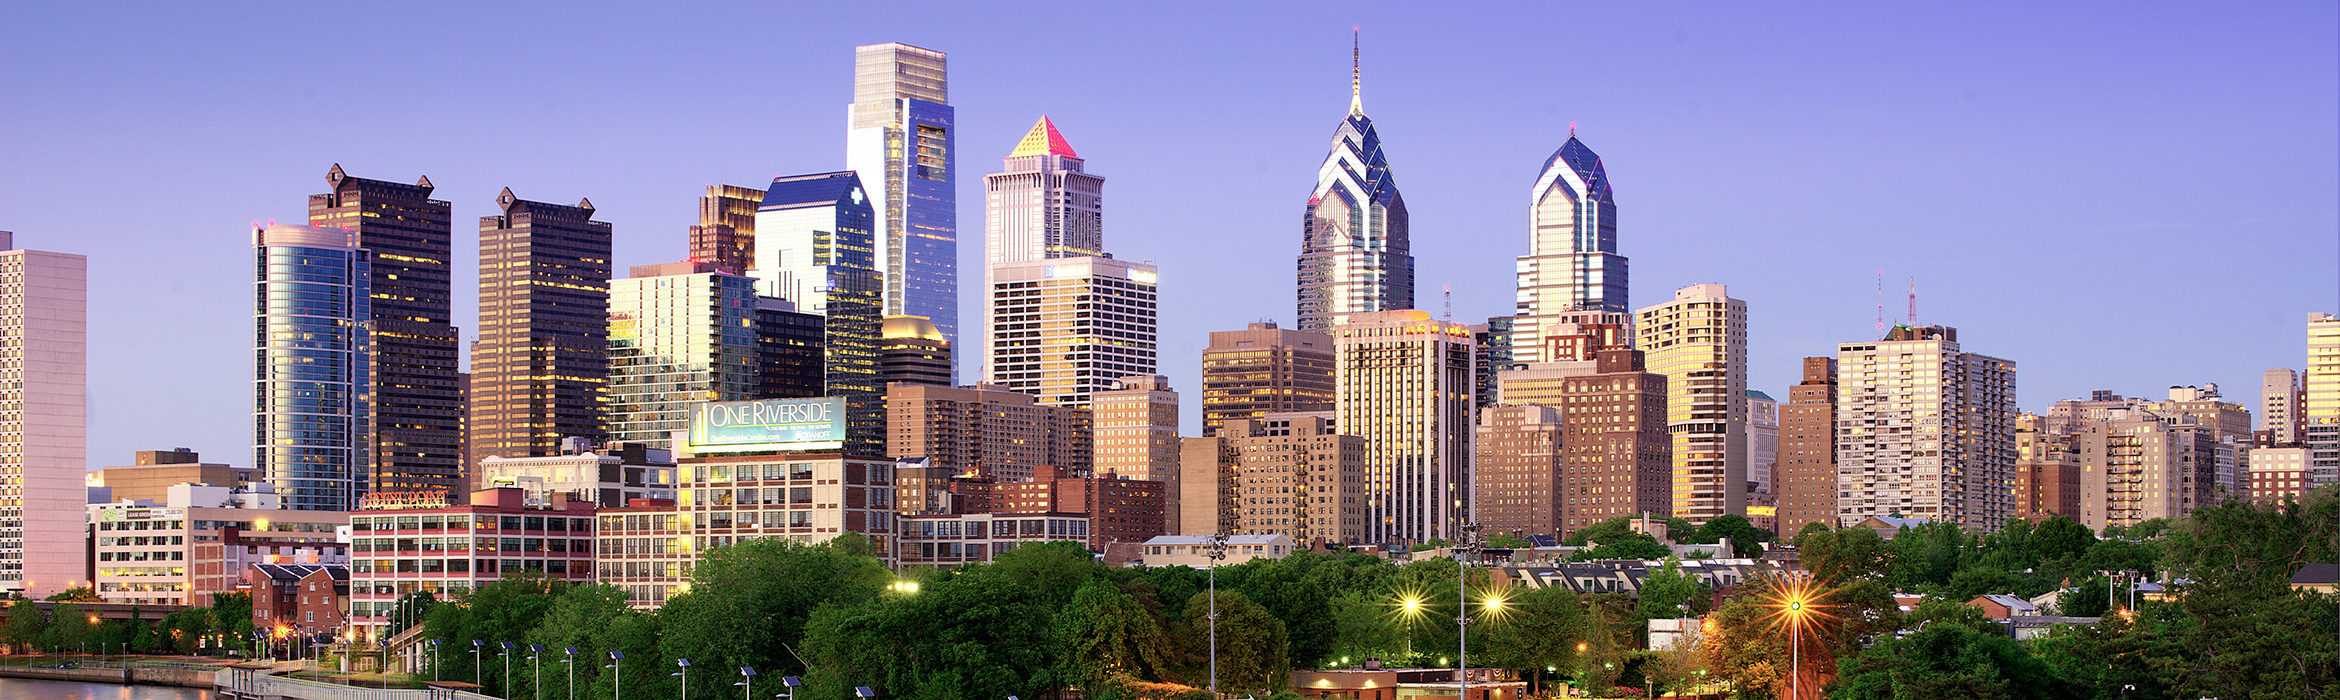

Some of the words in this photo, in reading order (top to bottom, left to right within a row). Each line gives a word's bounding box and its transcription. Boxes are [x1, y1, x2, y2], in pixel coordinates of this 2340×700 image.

[710, 404, 750, 428] ONE
[753, 401, 831, 431] RIVERSIDE
[802, 431, 831, 439] DRANOFF
[408, 490, 449, 508] POINT
